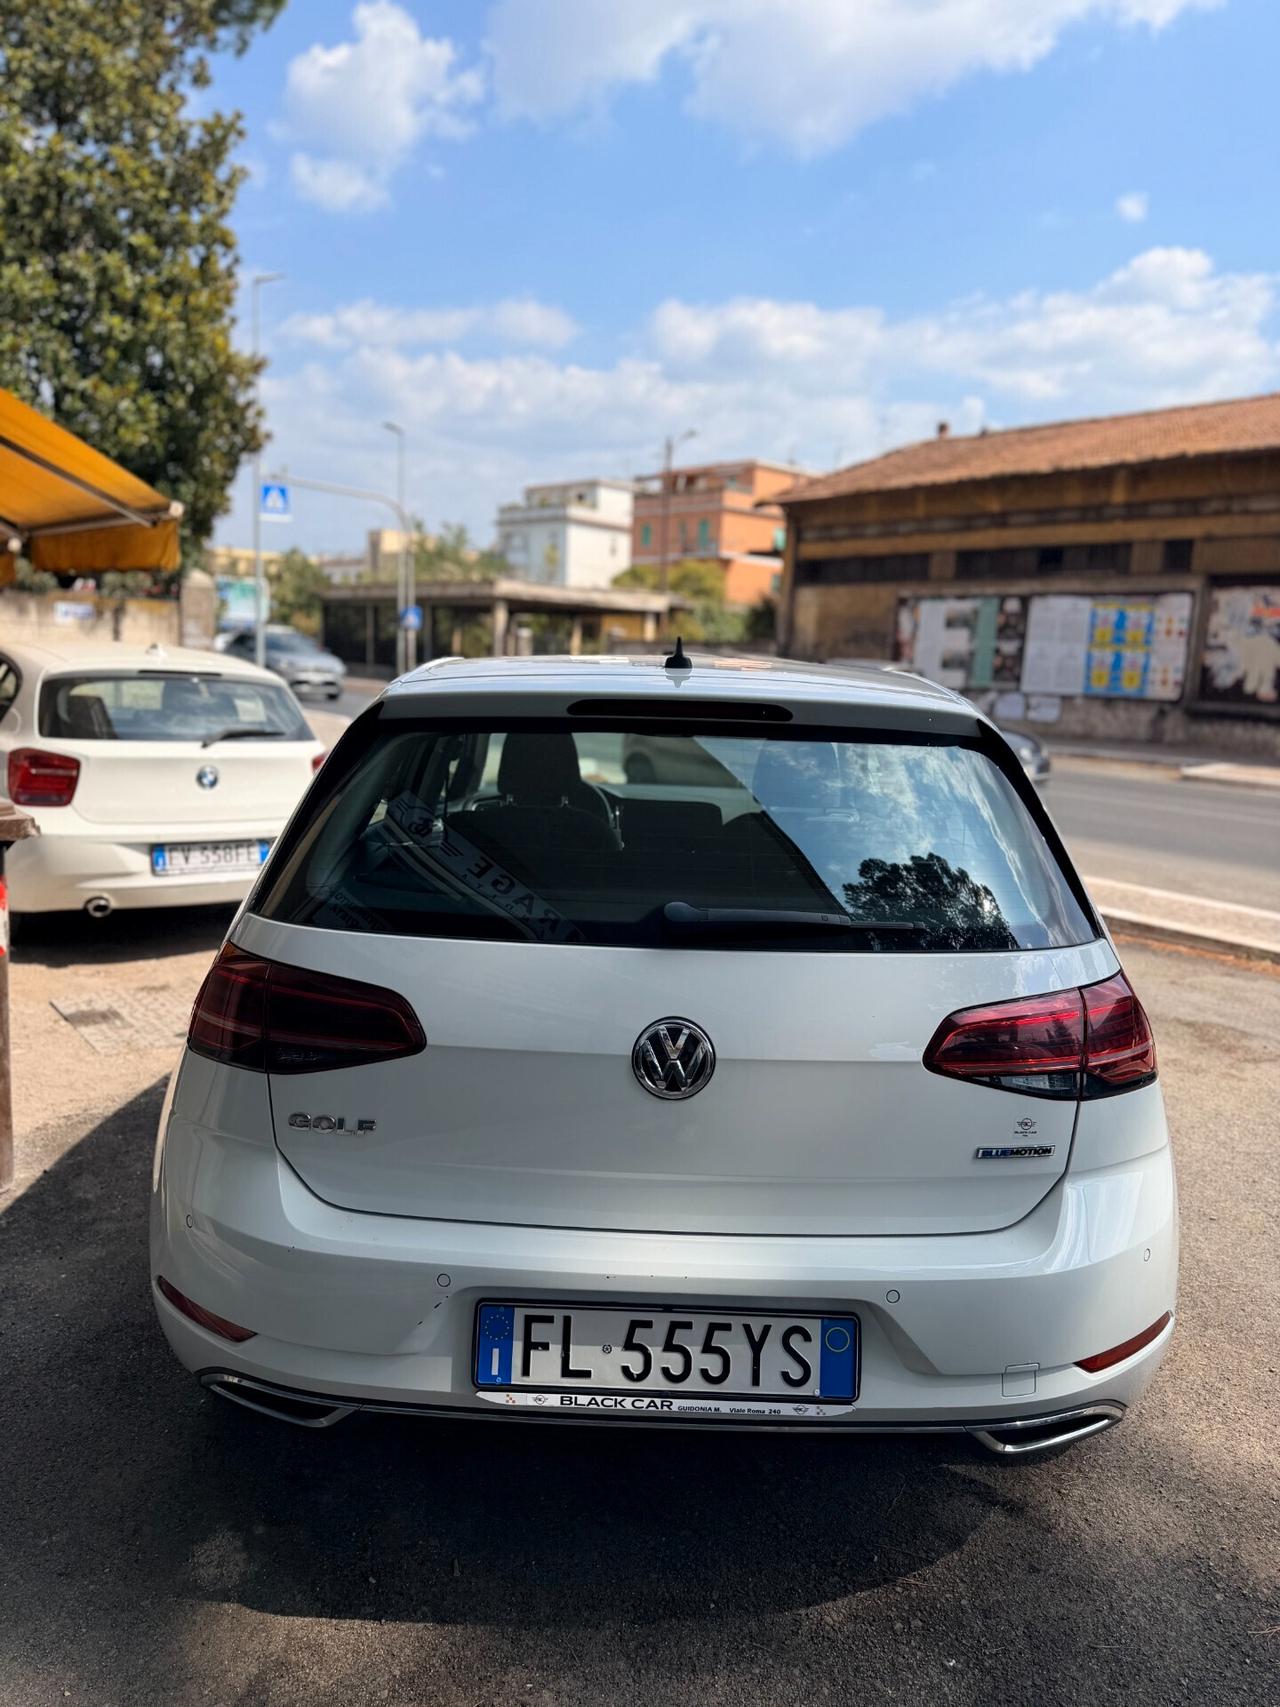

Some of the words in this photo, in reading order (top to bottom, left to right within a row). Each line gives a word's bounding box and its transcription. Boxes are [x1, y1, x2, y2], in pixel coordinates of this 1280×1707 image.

[638, 1024, 708, 1093] VW
[288, 1112, 376, 1136] GOLF
[981, 1146, 1052, 1157] BLUEMOTION
[491, 1347, 499, 1376] I
[521, 1314, 593, 1380] FL
[620, 1319, 813, 1388] 555YS
[559, 1395, 628, 1409] BLACK
[631, 1398, 673, 1411] CAR
[677, 1404, 712, 1413] GUIDONIA
